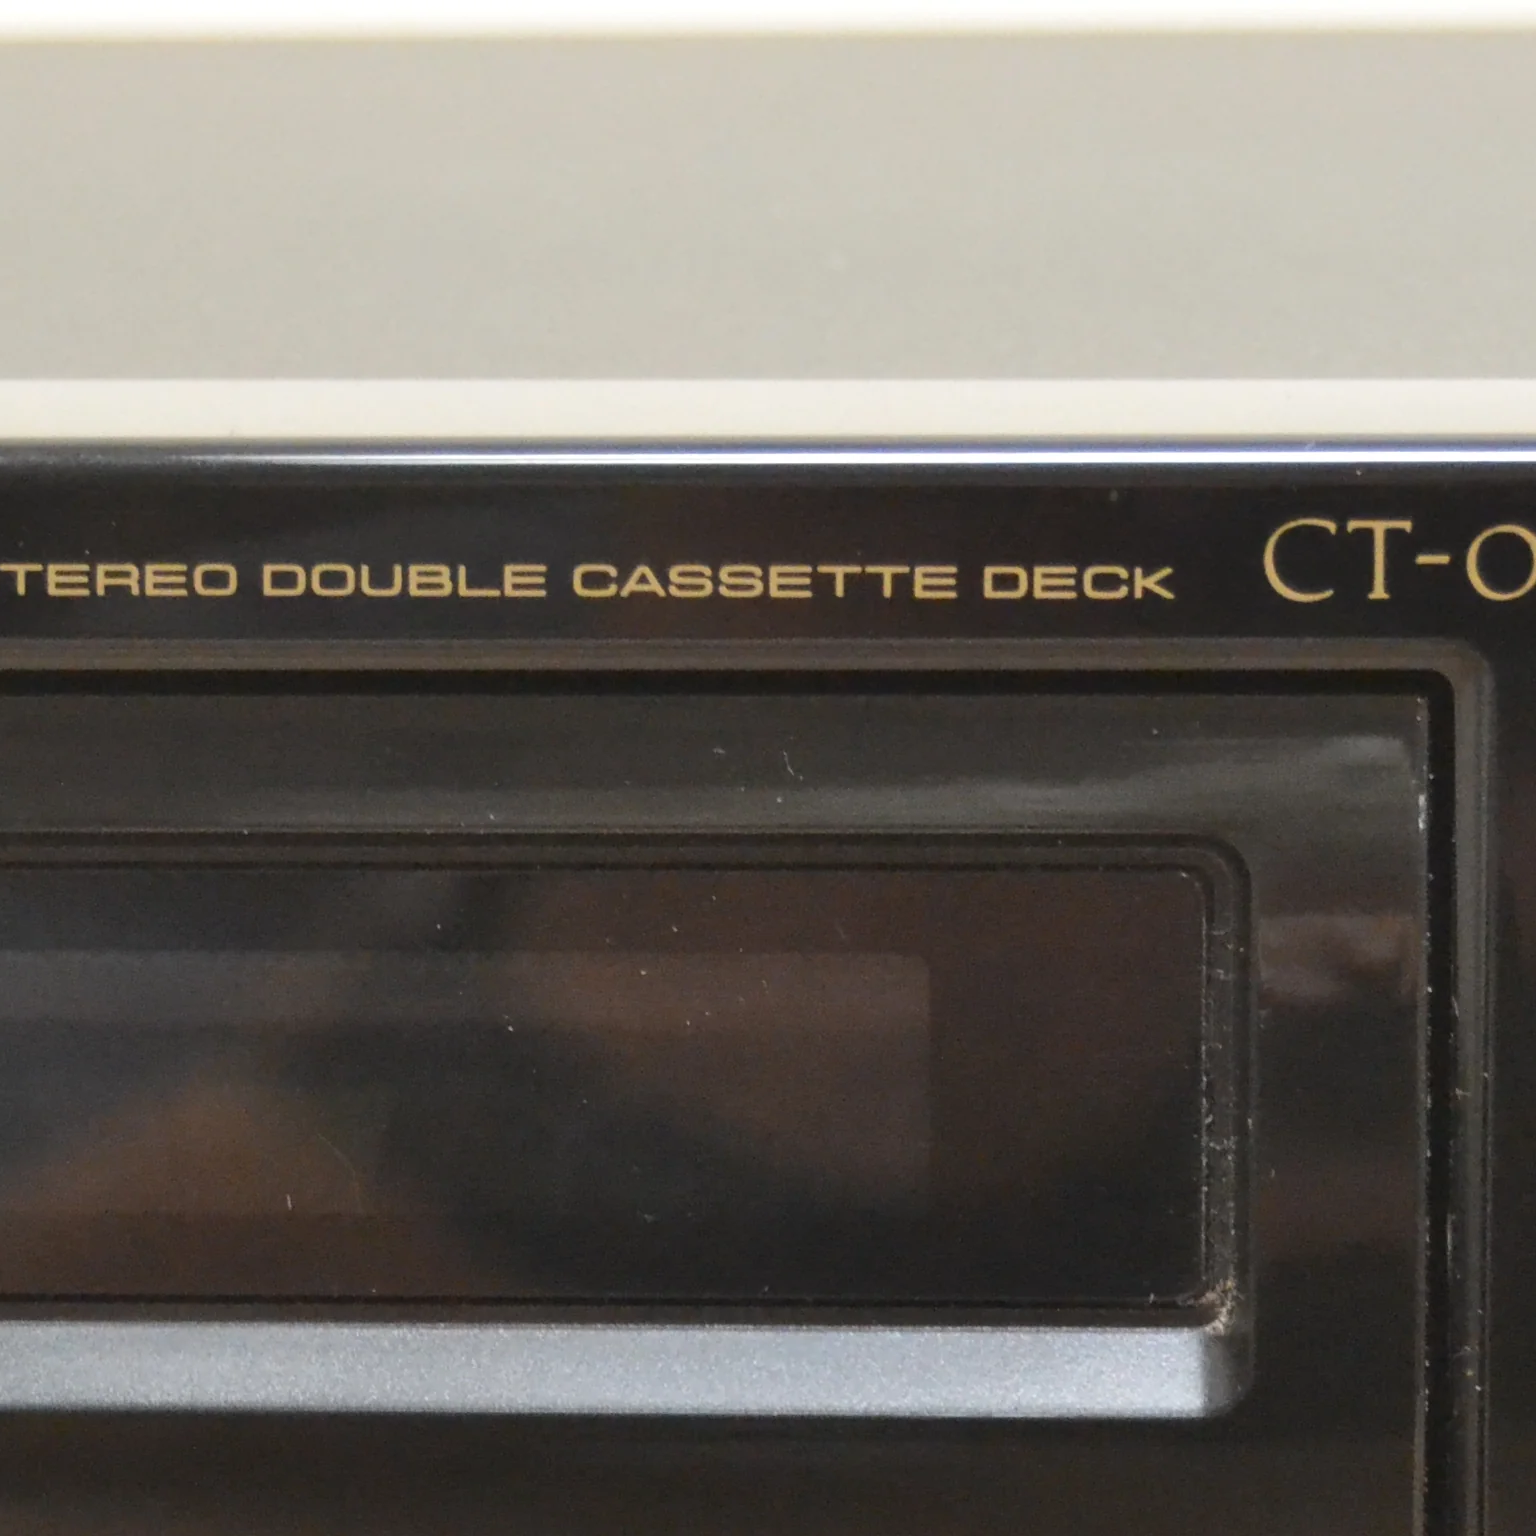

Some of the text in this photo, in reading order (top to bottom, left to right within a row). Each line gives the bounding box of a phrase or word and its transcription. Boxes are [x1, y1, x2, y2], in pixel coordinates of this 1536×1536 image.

[262, 563, 548, 598] DOUBLE
[572, 563, 958, 600] CASSETTE
[982, 565, 1175, 600] DECK
